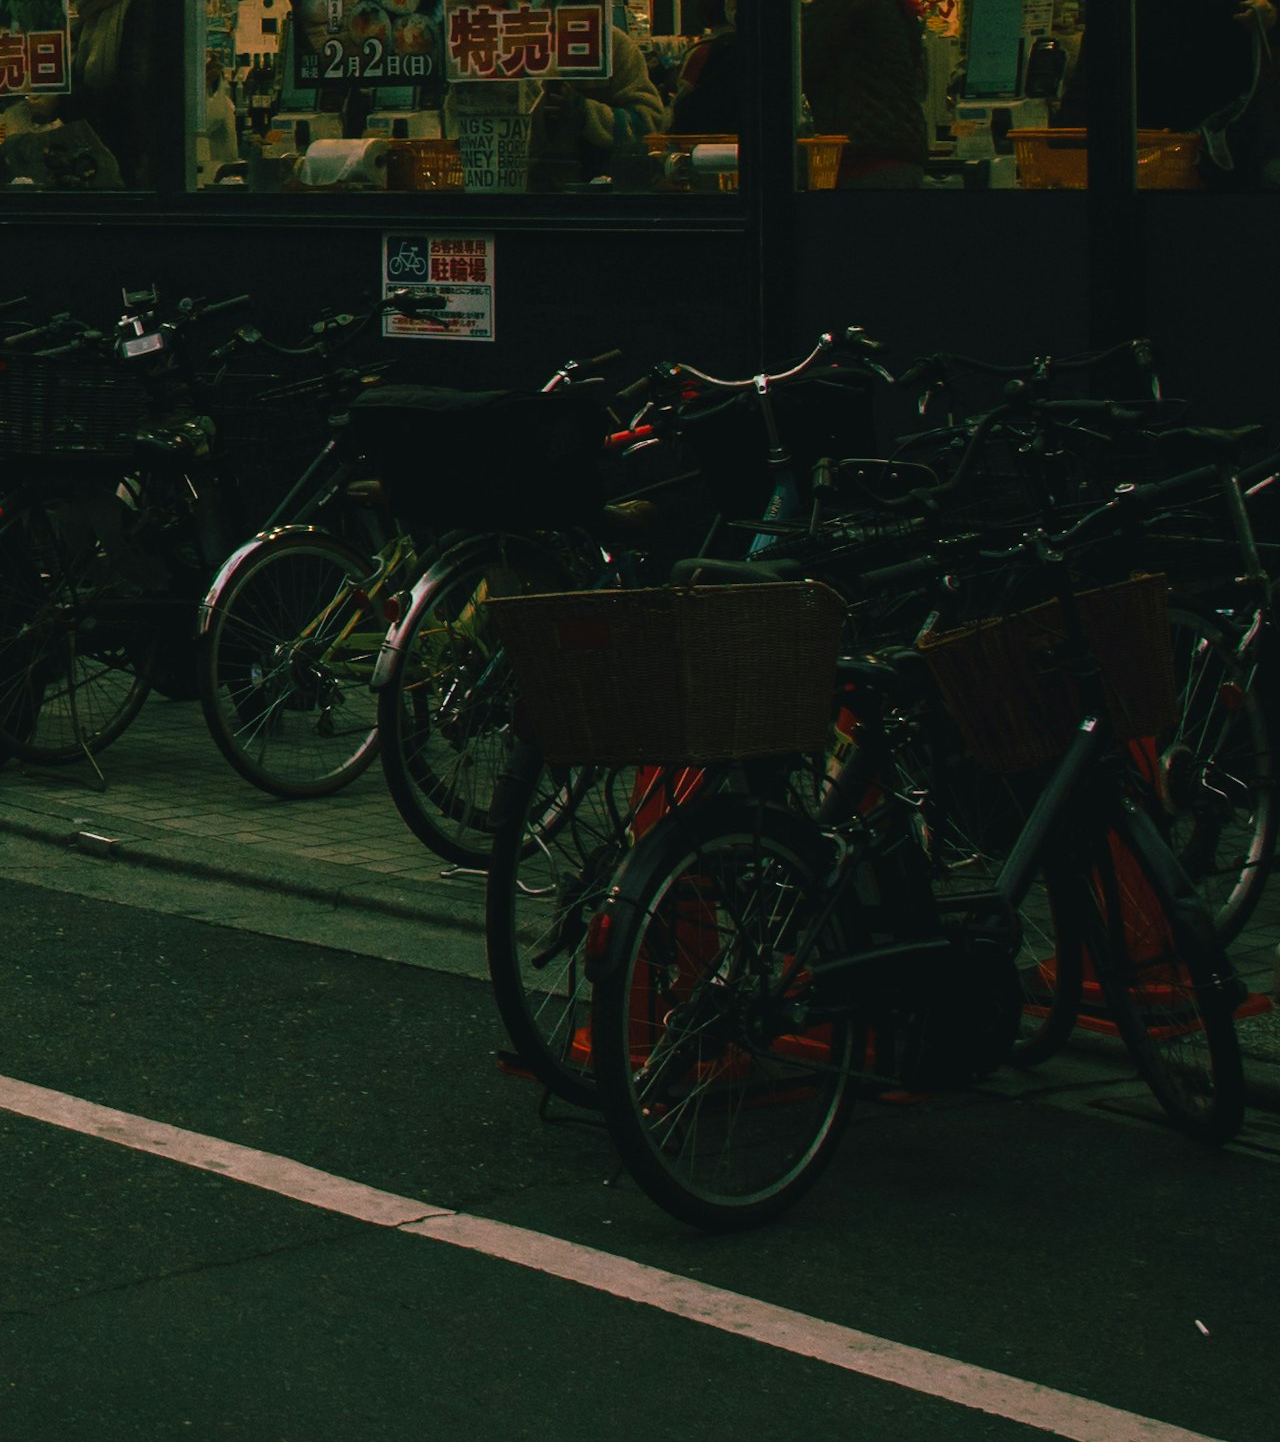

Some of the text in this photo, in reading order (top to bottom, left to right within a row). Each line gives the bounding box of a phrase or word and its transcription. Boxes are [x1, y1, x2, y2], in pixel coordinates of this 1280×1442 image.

[448, 5, 603, 76] 特売日
[430, 240, 486, 254] お客様専用
[430, 258, 487, 282] 駐輪場
